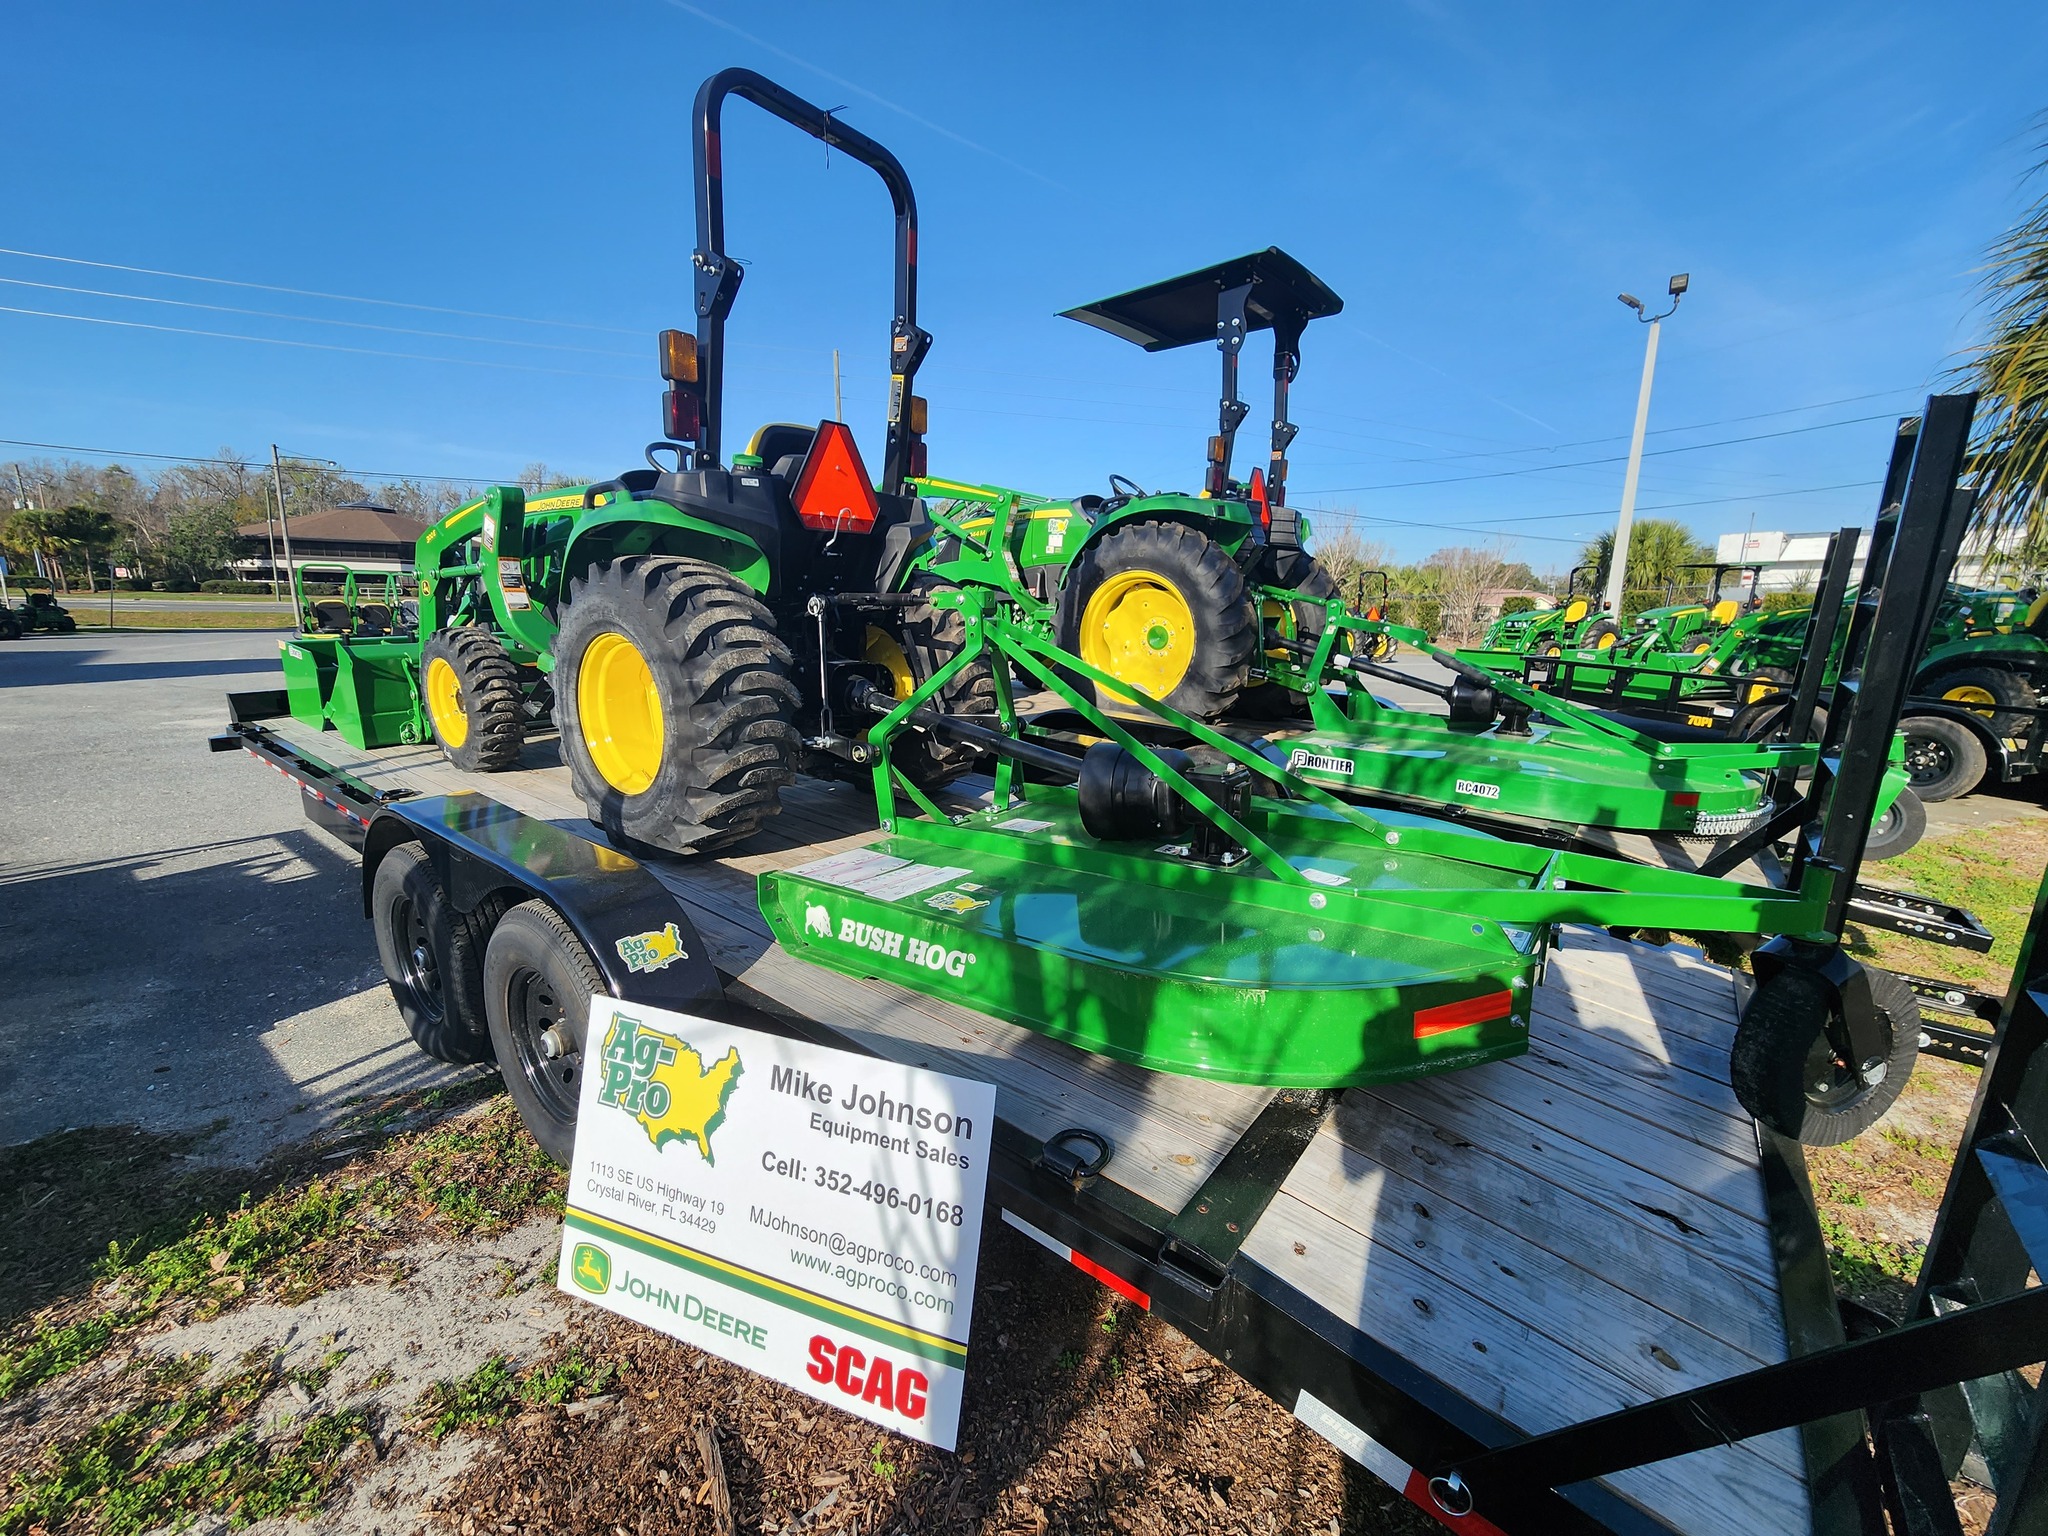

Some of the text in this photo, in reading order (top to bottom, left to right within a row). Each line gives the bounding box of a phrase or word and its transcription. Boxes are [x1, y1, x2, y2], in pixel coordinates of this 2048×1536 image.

[537, 499, 581, 510] JOHN DEERE
[1293, 750, 1353, 773] FRONTIER
[1457, 781, 1498, 797] RC4072
[627, 949, 659, 969] Pro
[838, 917, 904, 959] BUSH
[605, 1017, 677, 1080] Ag-
[598, 1062, 672, 1119] Pro
[770, 1064, 973, 1139] Mike Johnson
[810, 1112, 970, 1169] Equipment Sales
[587, 1179, 717, 1234] Crystal River, FL 34429
[590, 1161, 725, 1216] 1113 SE US Highway 19
[761, 1151, 964, 1227] Cell: 352-496-0168
[749, 1205, 958, 1287] MJohnson@agproco.com
[615, 1270, 768, 1350] JOHN DEERE
[790, 1249, 955, 1315] www.agproco.com
[806, 1334, 928, 1420] SCAG
